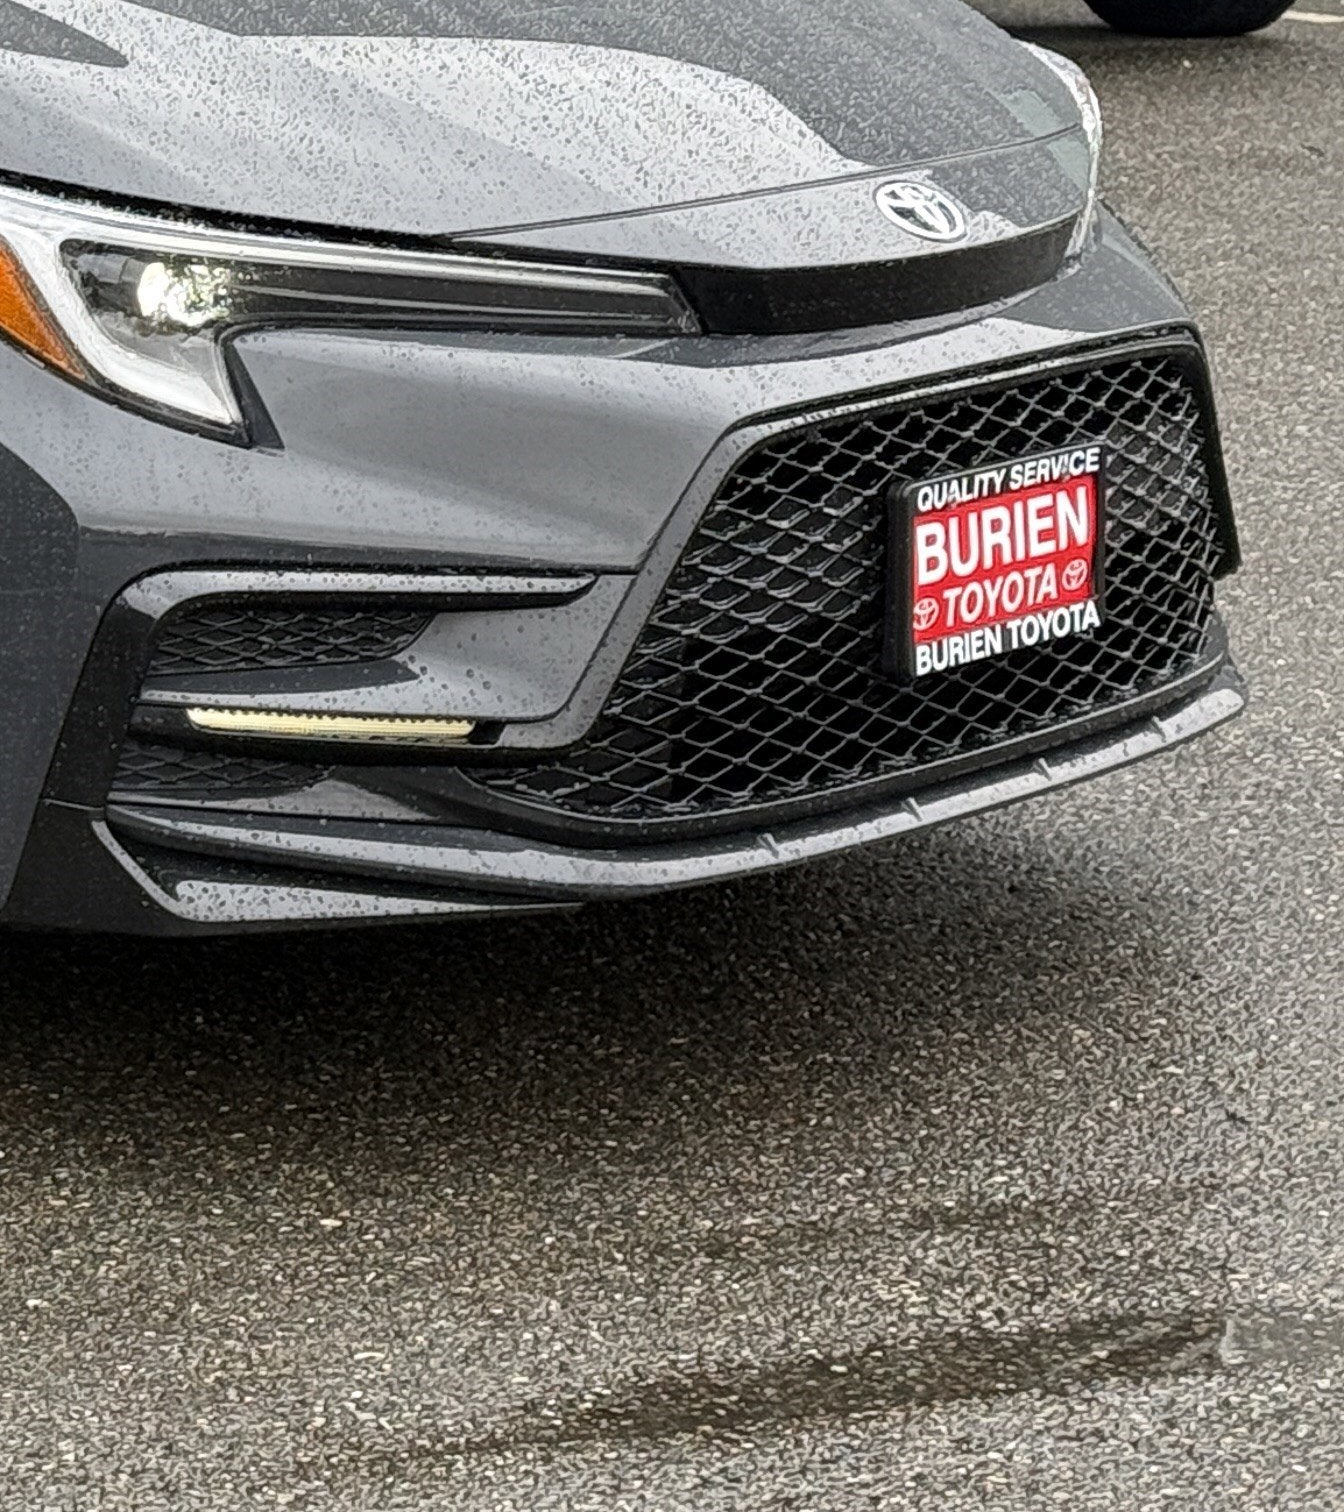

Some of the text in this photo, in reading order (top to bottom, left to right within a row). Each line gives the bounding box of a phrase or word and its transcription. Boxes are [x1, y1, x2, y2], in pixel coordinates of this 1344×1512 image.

[917, 447, 1101, 512] QUALITY SERVICE
[915, 486, 1090, 587] BURIEN
[942, 562, 1059, 628] TOYOTA
[915, 600, 1101, 677] BURIEN TOYOTA
